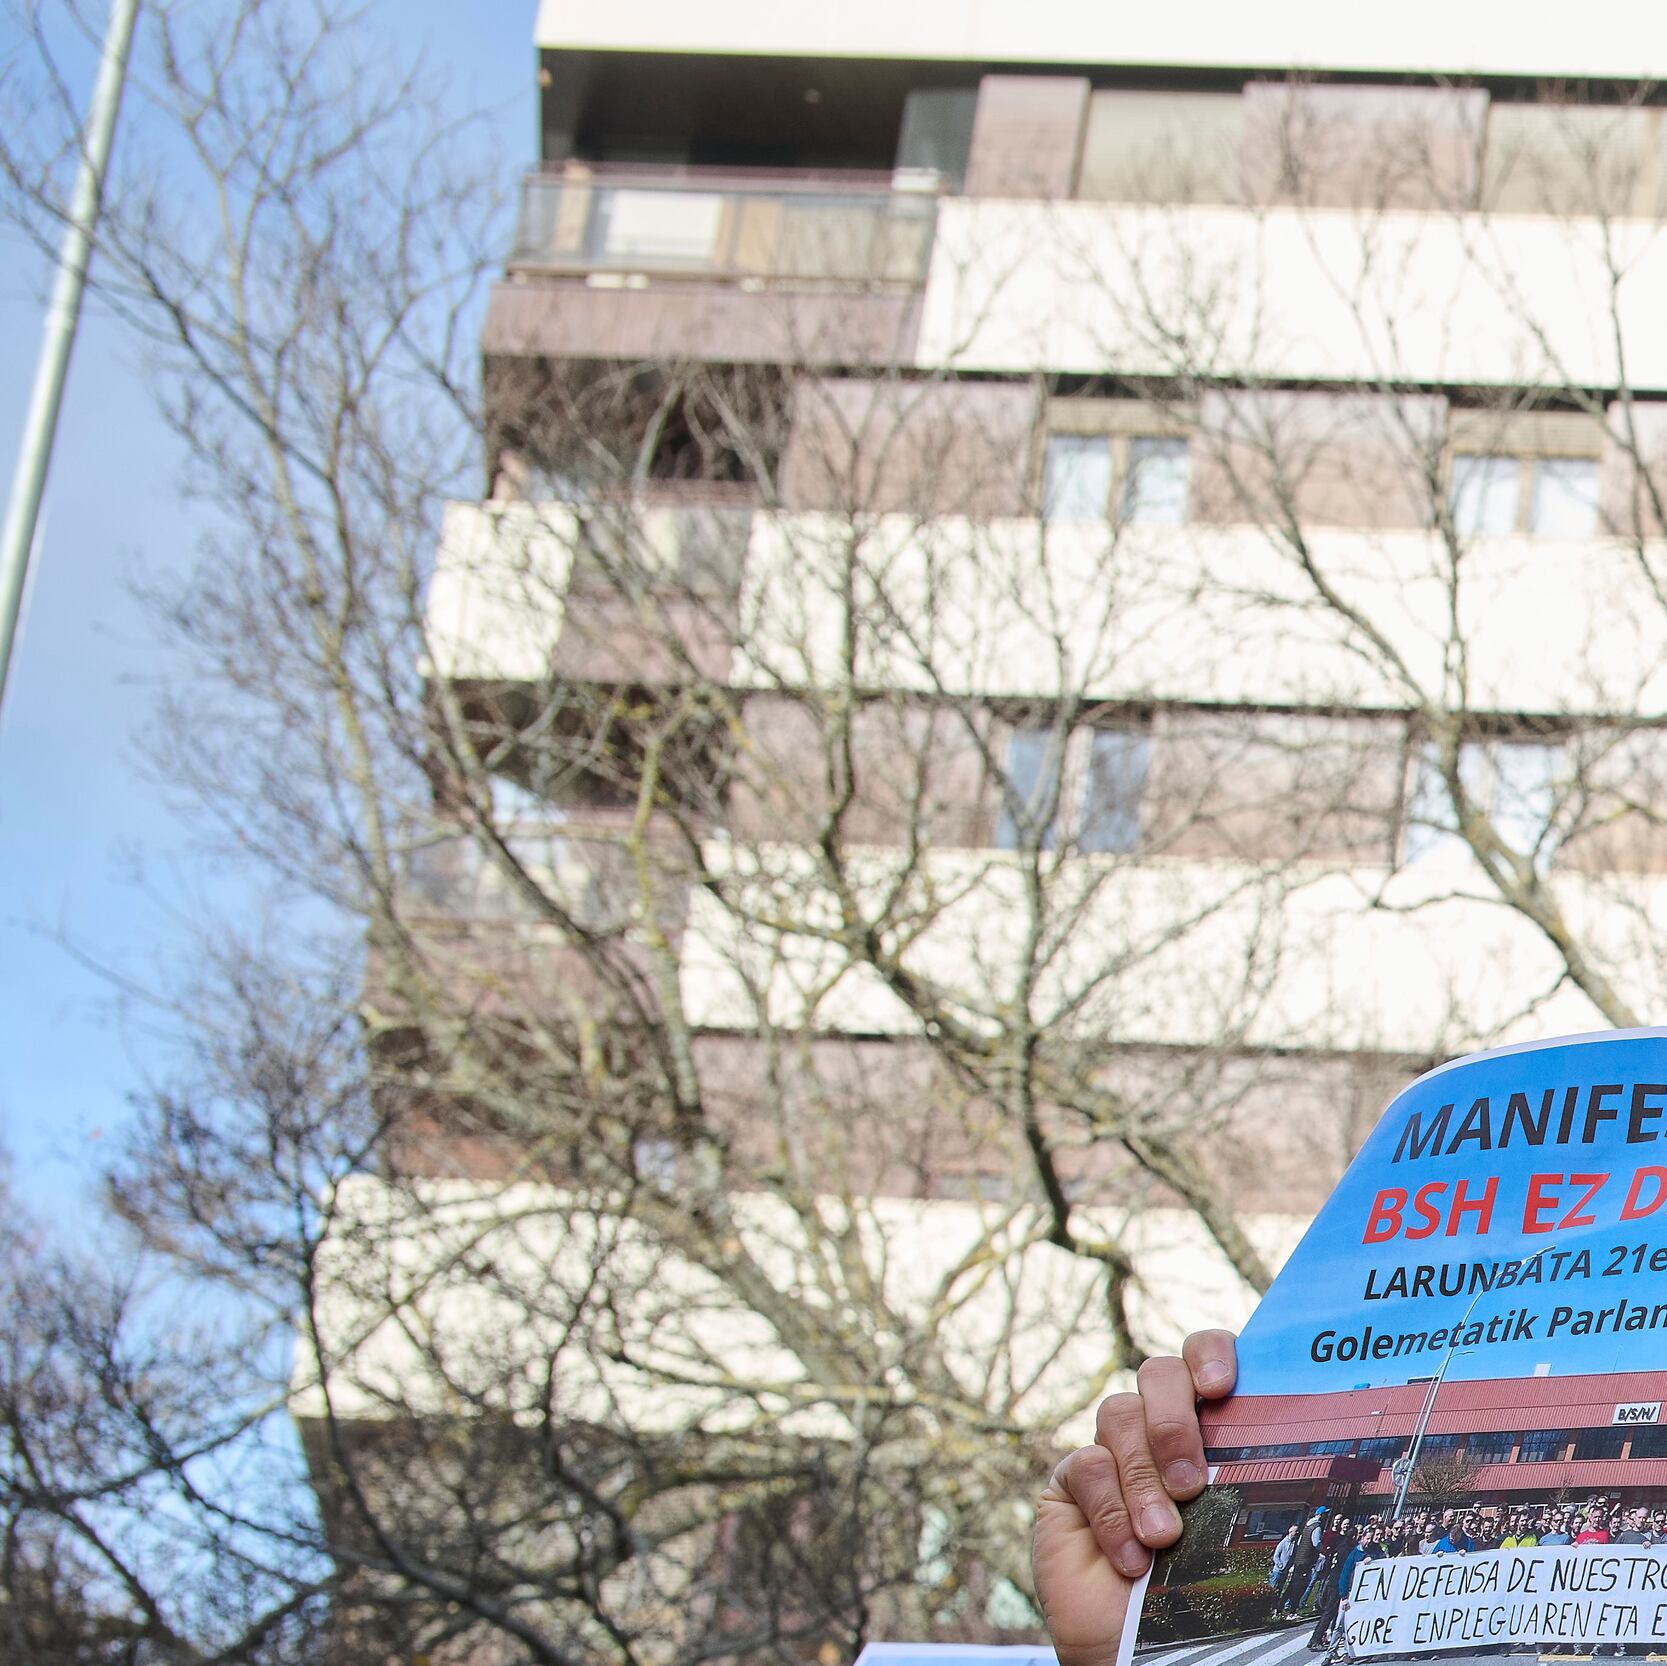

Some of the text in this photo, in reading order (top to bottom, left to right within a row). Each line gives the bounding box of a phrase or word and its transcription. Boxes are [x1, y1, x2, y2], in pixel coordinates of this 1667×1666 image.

[1361, 1176, 1500, 1245] BSH
[1521, 1172, 1611, 1235] EZ
[1363, 1249, 1593, 1301] LARUNBATA
[1309, 1308, 1540, 1364] Golemetatik
[1353, 1564, 1397, 1602] EN
[1402, 1559, 1499, 1600] DEFENSA
[1507, 1557, 1545, 1594] DE
[1346, 1614, 1400, 1648] GURE
[1413, 1601, 1593, 1645] ENPLEGUAREN
[1597, 1604, 1639, 1637] ETA
